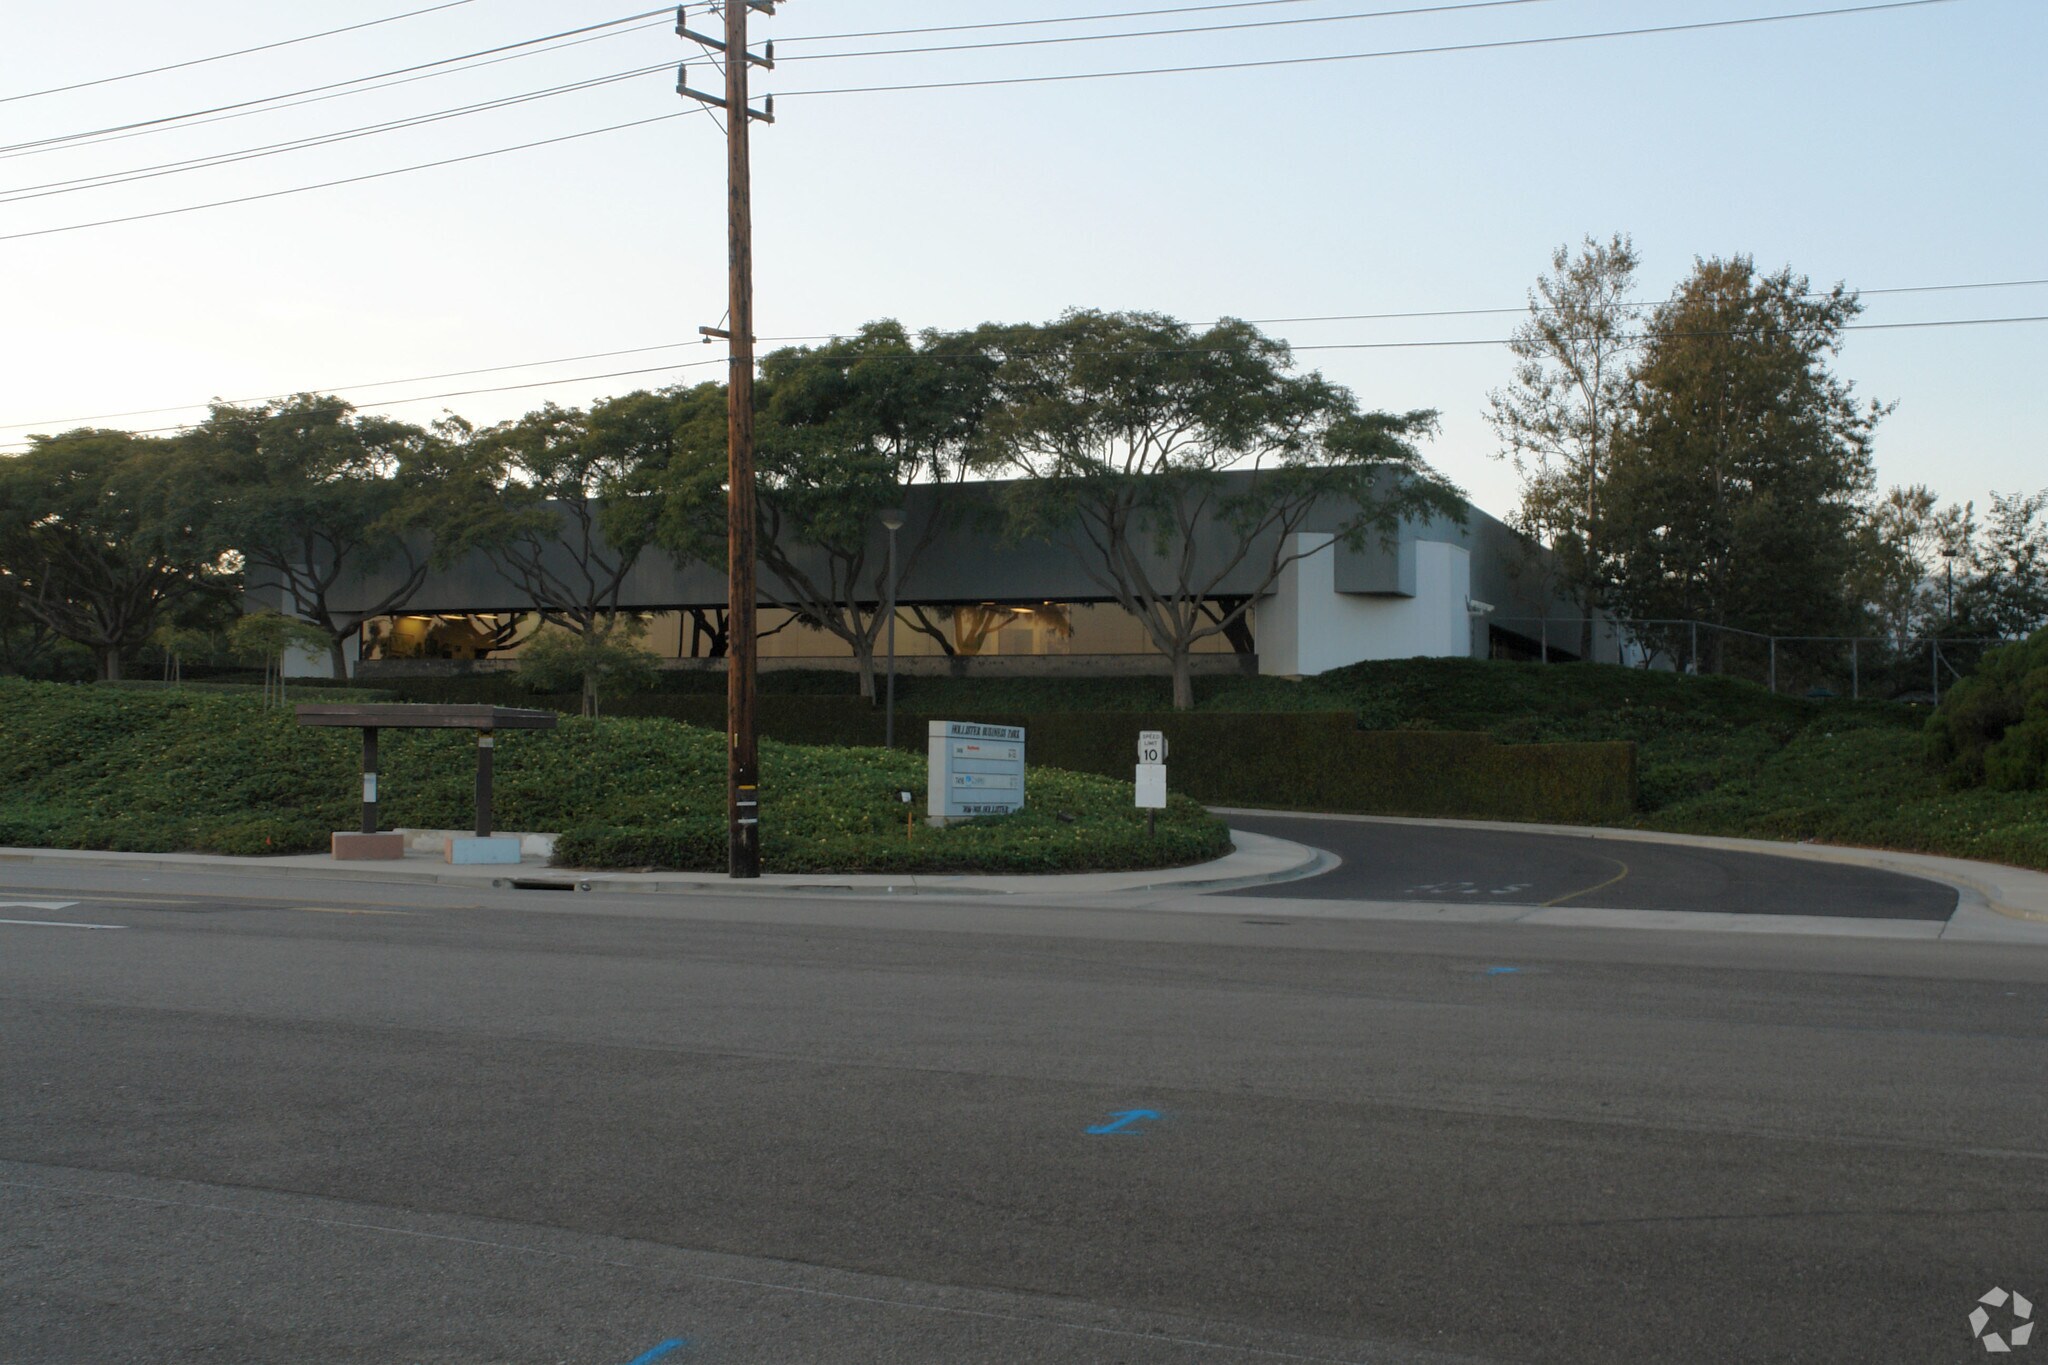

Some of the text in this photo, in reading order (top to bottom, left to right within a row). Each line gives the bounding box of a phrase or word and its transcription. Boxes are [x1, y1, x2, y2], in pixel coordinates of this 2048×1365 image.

[952, 724, 1020, 739] HOLLISTER BUSINESS PARK
[1144, 749, 1158, 761] 10
